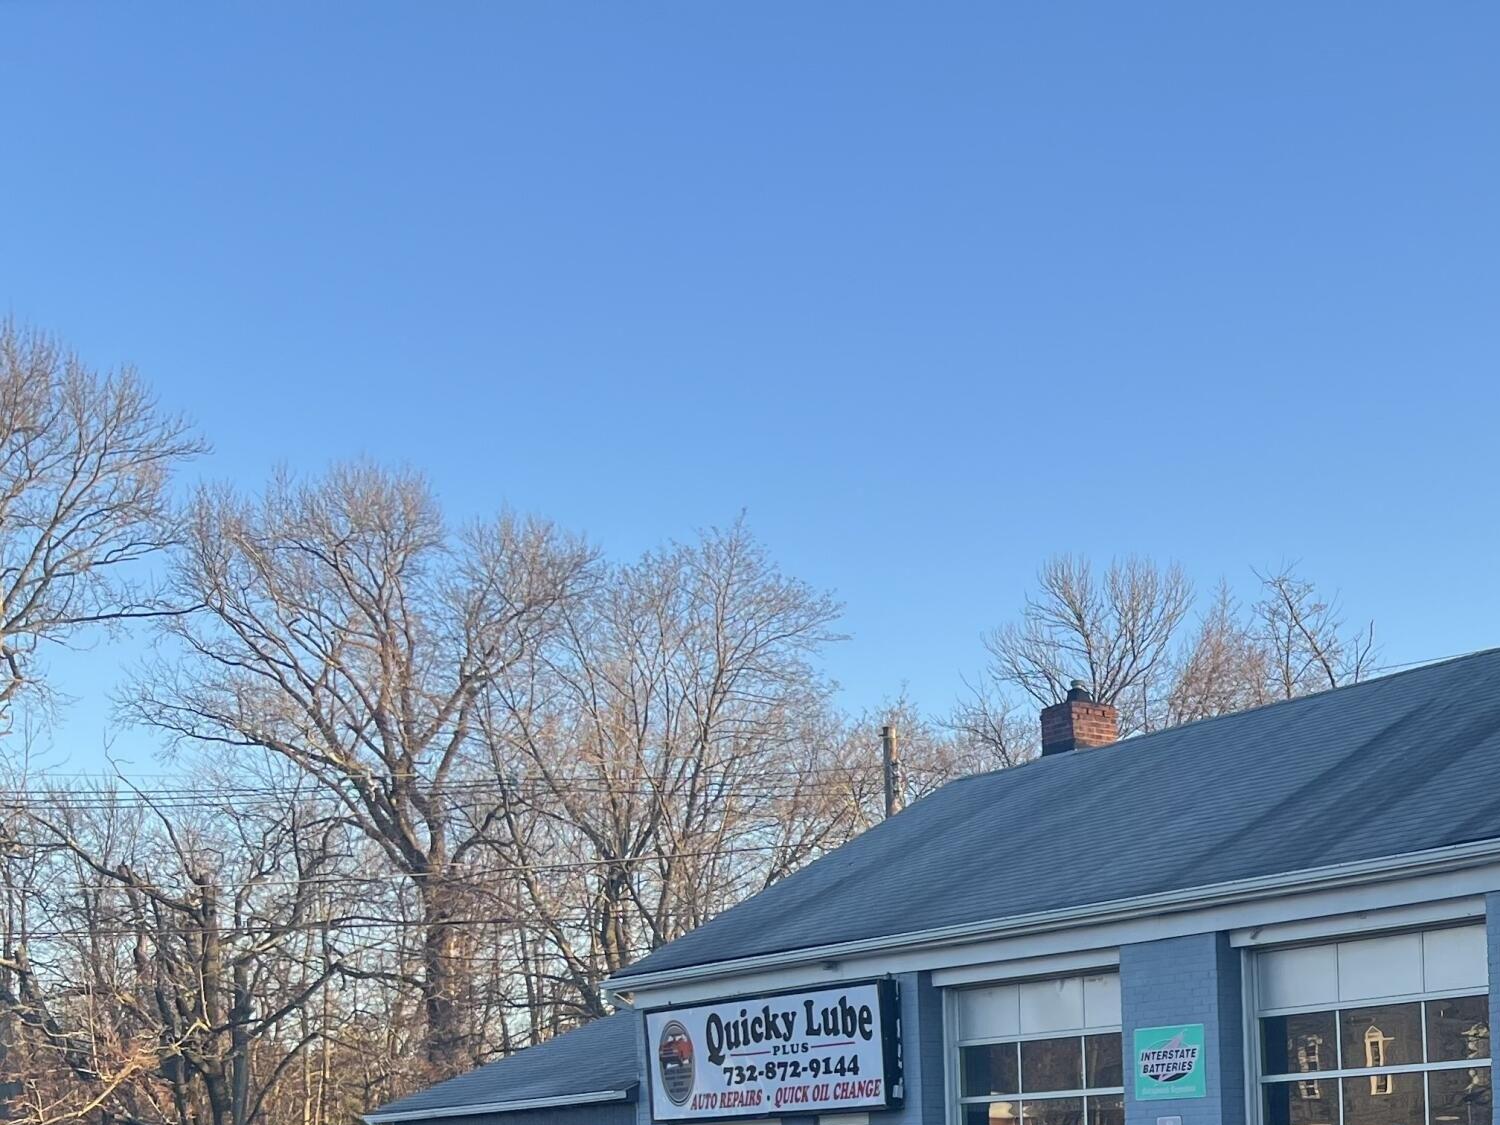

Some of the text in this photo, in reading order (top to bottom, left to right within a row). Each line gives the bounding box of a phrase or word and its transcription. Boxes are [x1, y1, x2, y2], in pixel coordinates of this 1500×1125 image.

[705, 995, 873, 1066] Quicky Lube
[772, 1042, 809, 1056] PLUS
[1141, 1048, 1197, 1062] INTERSTATE
[723, 1055, 860, 1086] 732-872-9144
[1142, 1061, 1193, 1074] BATTERIES
[690, 1078, 882, 1111] AUTO REPAIRS QUICK OIL CHANGE
